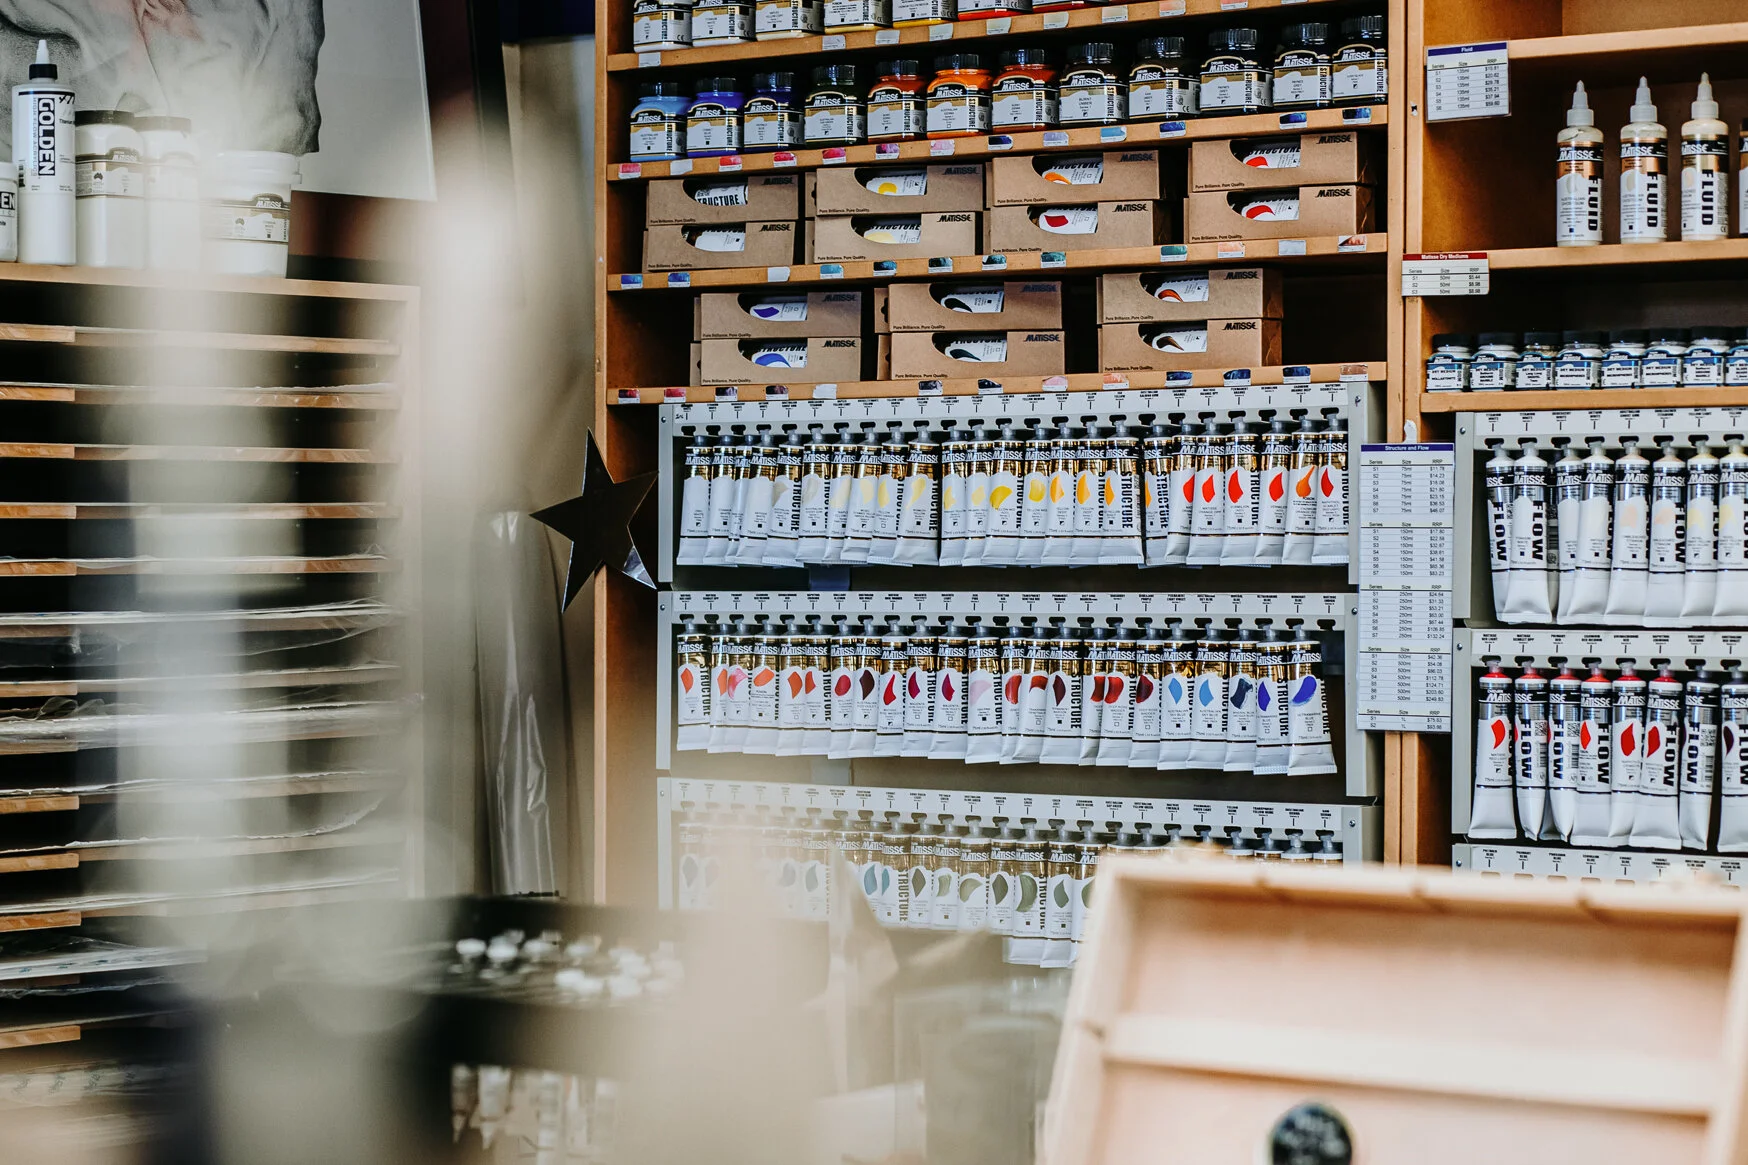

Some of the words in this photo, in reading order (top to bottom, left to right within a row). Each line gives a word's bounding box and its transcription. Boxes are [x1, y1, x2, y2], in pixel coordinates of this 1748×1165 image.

[1245, 73, 1253, 104] STRUCTURE
[1376, 61, 1384, 92] STRUCTURE
[1035, 91, 1043, 121] STRUCTURE
[1106, 87, 1114, 117] STRUCTURE
[1166, 81, 1174, 111] STRUCTURE
[38, 98, 55, 176] GOLDEN
[1316, 134, 1352, 144] MATISSE
[1621, 146, 1654, 156] MATISSE
[1119, 153, 1155, 162] MATISSE
[1559, 150, 1594, 160] MATISSE
[943, 166, 979, 175] MATISSE
[697, 194, 740, 206] TRUCTURE
[1112, 203, 1149, 212] MATISSE
[1315, 189, 1352, 198] MATISSE
[1588, 176, 1599, 231] FLUID
[1646, 172, 1658, 227] FLUID
[1702, 169, 1714, 226] FLUID
[760, 224, 791, 232] MATISSE
[937, 214, 973, 222] MATISSE
[1224, 271, 1260, 280] MATISSE
[1023, 334, 1061, 342] MATISSE
[1222, 322, 1259, 330] MATISSE
[823, 340, 857, 348] MATISSE
[908, 454, 939, 463] MATISSE
[790, 478, 803, 532] STRUCTURE
[1121, 471, 1133, 529] STRUCTURE
[1156, 471, 1170, 529] STRUCTURE
[1493, 501, 1508, 561] FLOW
[1532, 500, 1544, 561] FLOW
[1675, 502, 1686, 564] FLOW
[1162, 651, 1192, 660] MATISSE
[1196, 651, 1228, 661] MATISSE
[700, 662, 711, 716] STRUCTURE
[1071, 674, 1082, 729] STRUCTURE
[1486, 694, 1511, 702] MATIS
[1277, 678, 1289, 737] STRUCTURE
[1521, 719, 1532, 779] FLOW
[1553, 719, 1564, 779] FLOW
[1598, 723, 1610, 784] FLOW
[1663, 725, 1677, 787] FLOW
[1686, 722, 1700, 784] FLOW
[898, 869, 909, 922] STRUCTURE
